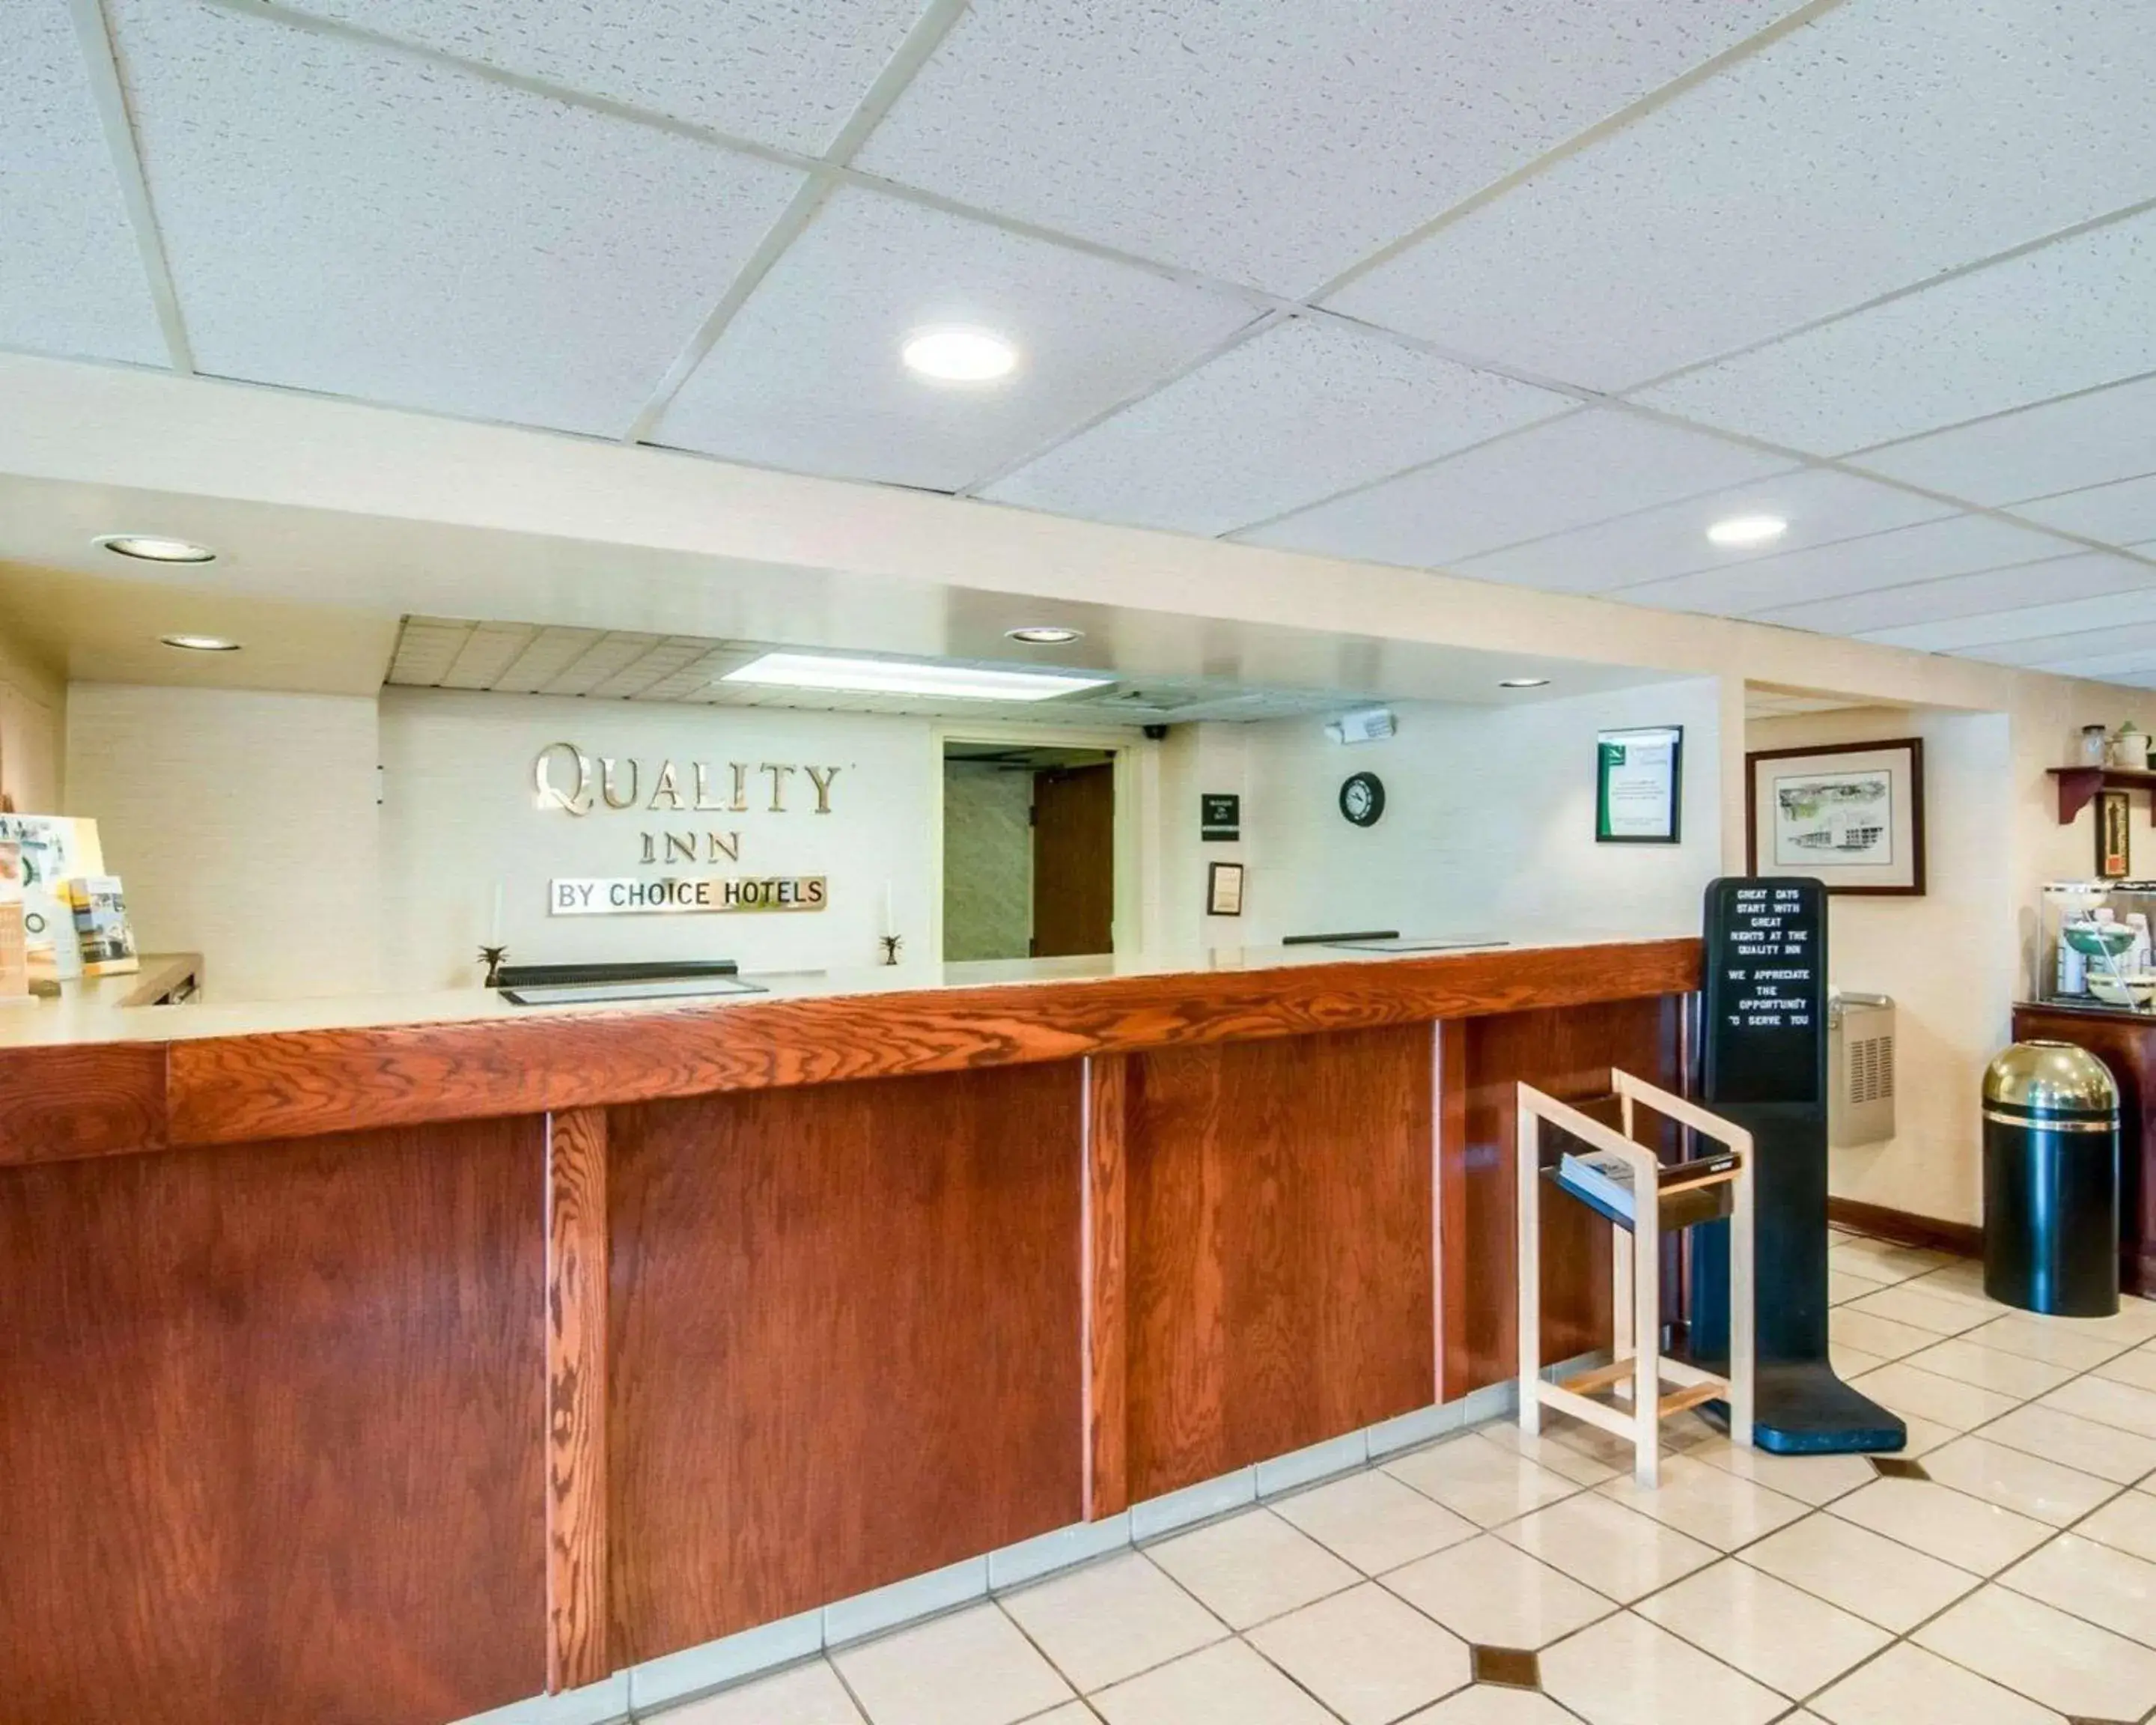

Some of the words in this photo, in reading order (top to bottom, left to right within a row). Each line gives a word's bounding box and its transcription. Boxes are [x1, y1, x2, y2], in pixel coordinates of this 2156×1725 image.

[534, 742, 841, 816] QUALITY
[639, 831, 743, 864] INN
[558, 883, 594, 907] BY
[610, 882, 710, 906] CHOICE
[725, 880, 823, 904] HOTELS
[1738, 889, 1767, 899] GREAT
[1737, 904, 1765, 913] START
[1773, 904, 1800, 913] WITH
[1751, 918, 1781, 927] GREAT
[1770, 931, 1782, 940] AT
[1788, 931, 1807, 940] THE
[1738, 946, 1779, 955] QUALITY
[1785, 945, 1801, 955] INN
[1729, 970, 1746, 979] WE
[1756, 987, 1777, 996] THE
[1791, 1015, 1809, 1025] YOU
